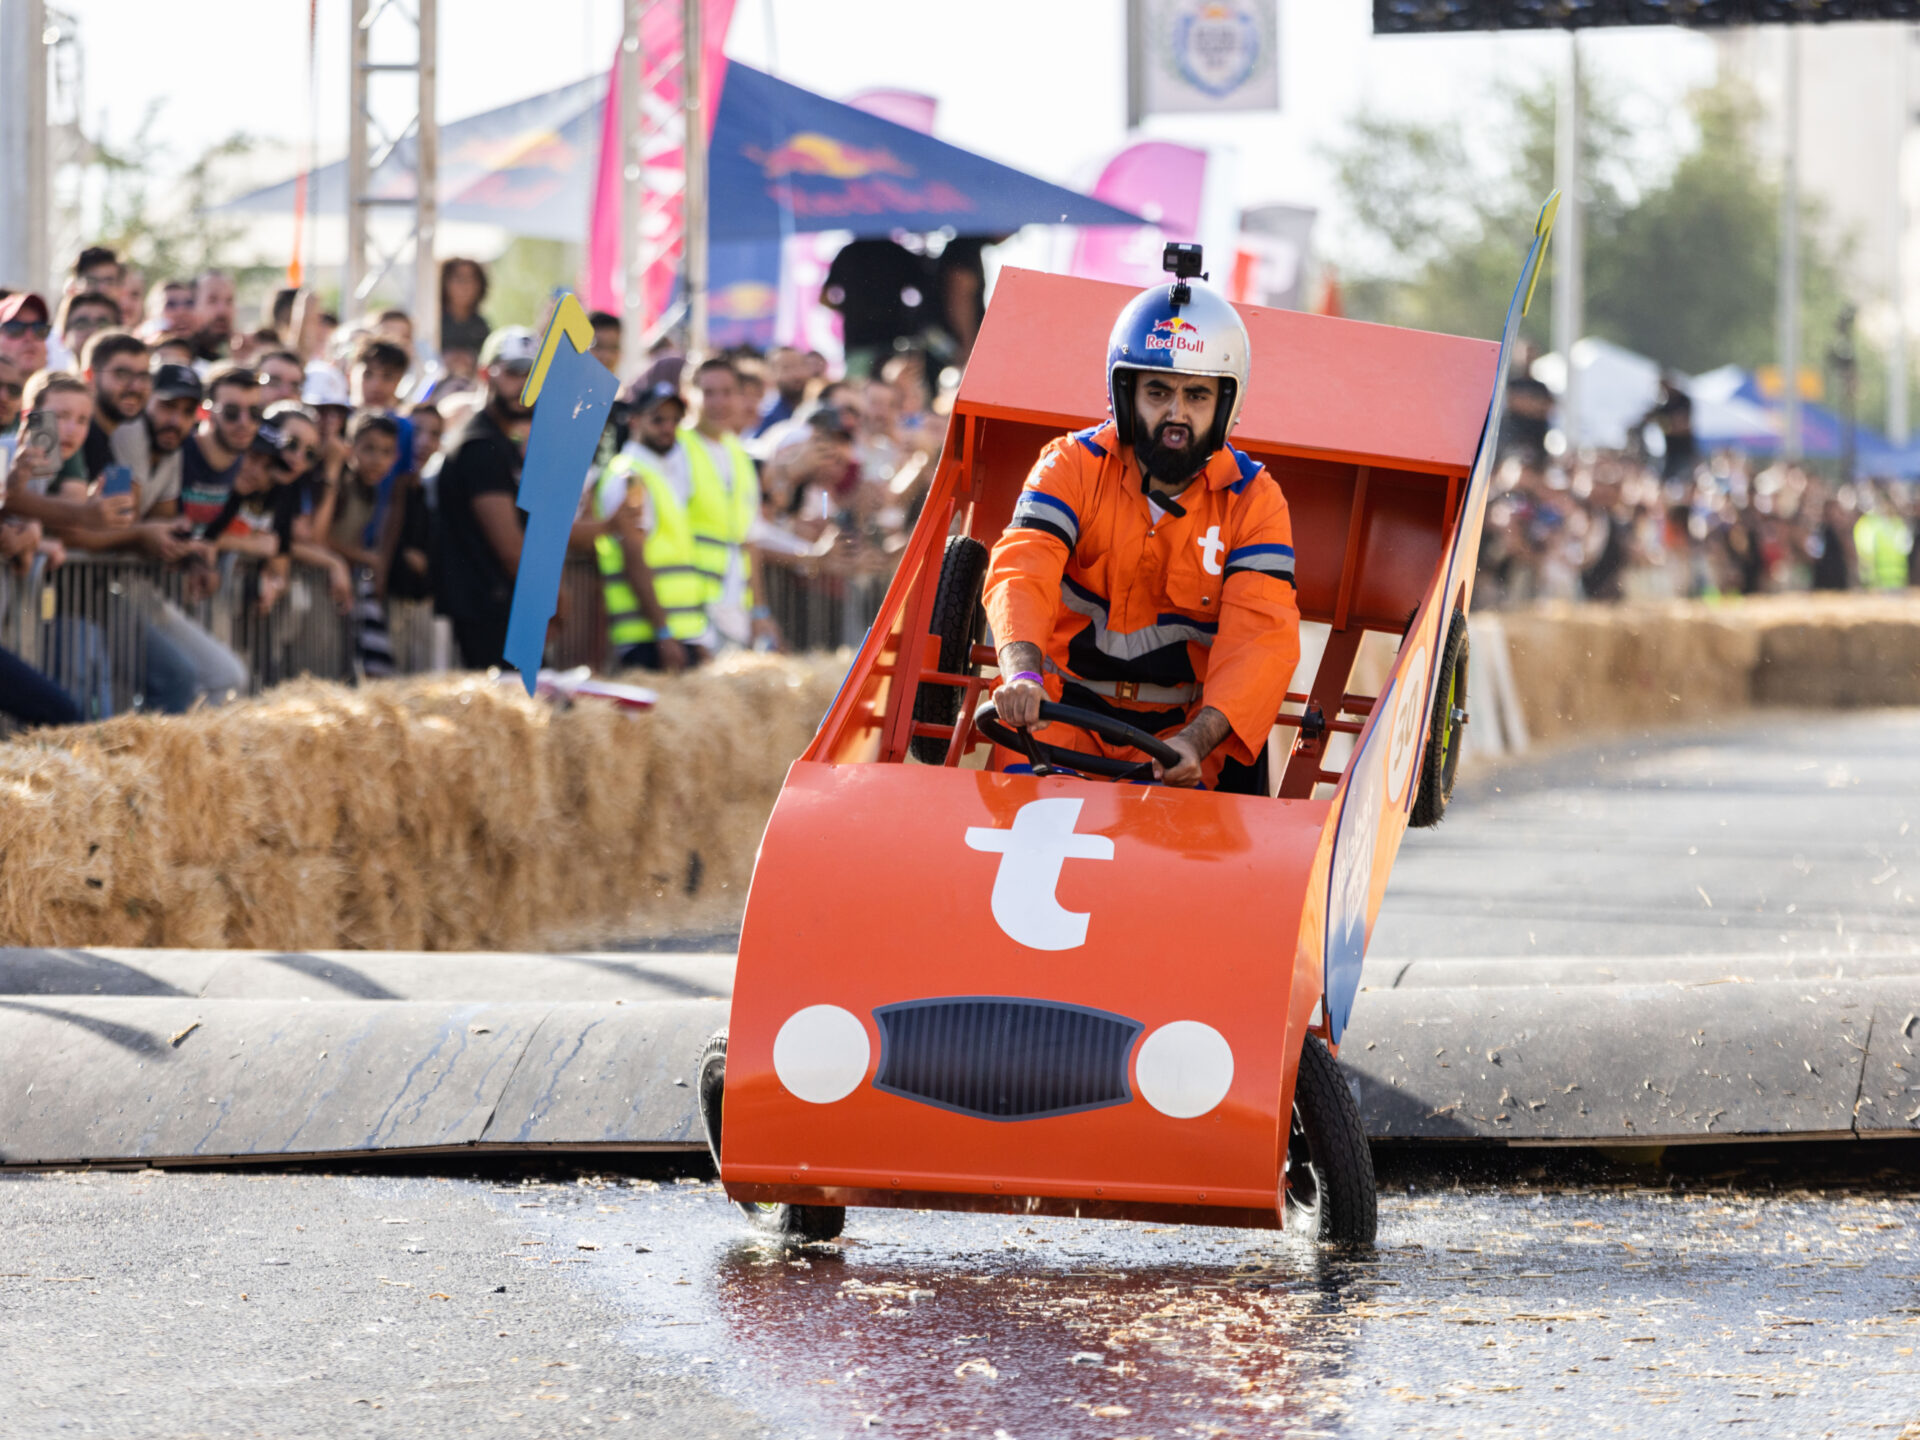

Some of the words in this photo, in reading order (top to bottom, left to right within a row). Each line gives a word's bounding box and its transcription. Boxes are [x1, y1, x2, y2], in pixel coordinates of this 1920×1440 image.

[1146, 334, 1175, 349] Red
[1176, 336, 1204, 353] Bull
[1197, 526, 1225, 575] t
[1393, 680, 1420, 772] 30
[964, 797, 1115, 951] t
